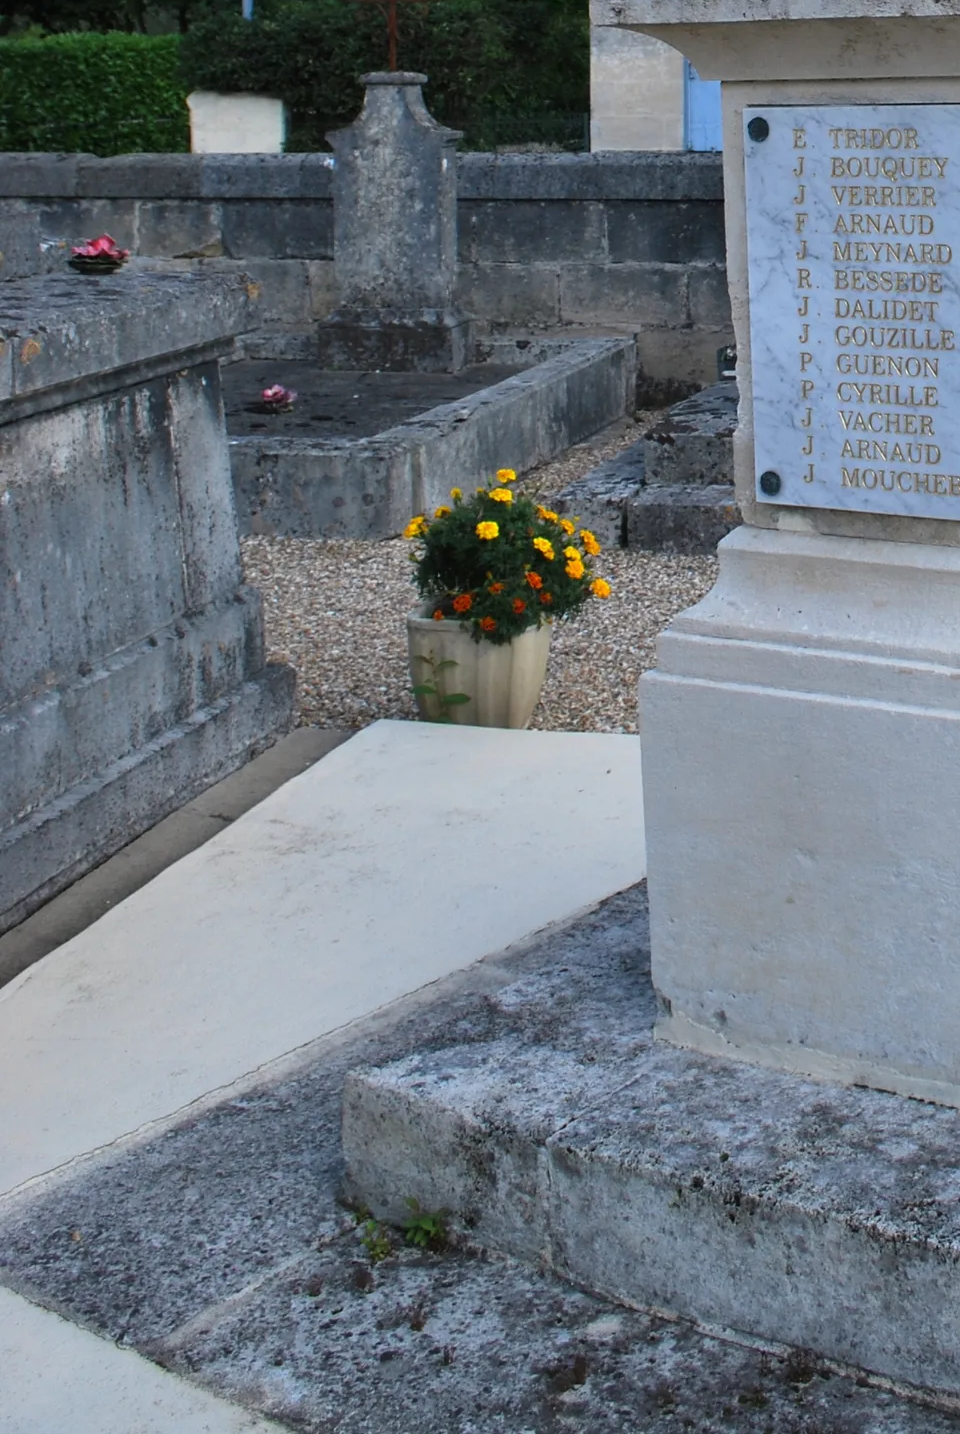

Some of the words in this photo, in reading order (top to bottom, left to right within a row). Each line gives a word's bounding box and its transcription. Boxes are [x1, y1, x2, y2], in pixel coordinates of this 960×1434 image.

[829, 128, 919, 149] TRIDOR
[830, 157, 949, 182] BOUQUEY
[831, 185, 937, 207] VERRIER
[832, 214, 934, 235] ARNAUD
[832, 242, 953, 264] MEYNARD
[834, 269, 943, 294] BESSEDE
[834, 298, 939, 322] DALIDET
[834, 325, 955, 351] GOUZILLE
[836, 354, 939, 378] GUENON
[836, 382, 939, 407] CYRILLE
[839, 410, 935, 436] VACHER
[840, 439, 941, 464] ARNAUD
